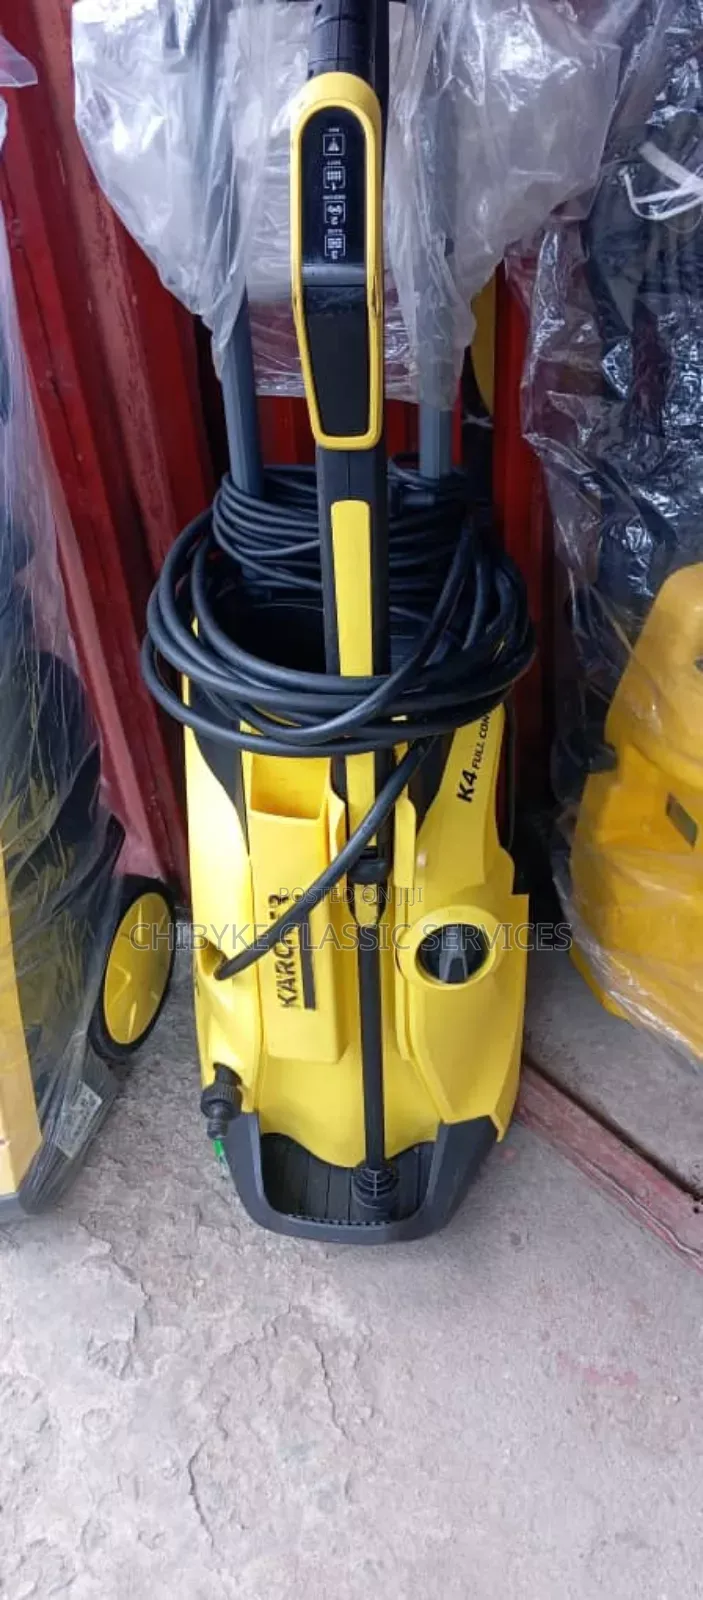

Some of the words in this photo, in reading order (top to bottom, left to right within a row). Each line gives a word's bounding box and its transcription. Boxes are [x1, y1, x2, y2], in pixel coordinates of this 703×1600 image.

[457, 769, 477, 803] K4
[472, 742, 485, 769] FULL
[479, 714, 490, 739] CON
[268, 893, 301, 1008] KÄRCR
